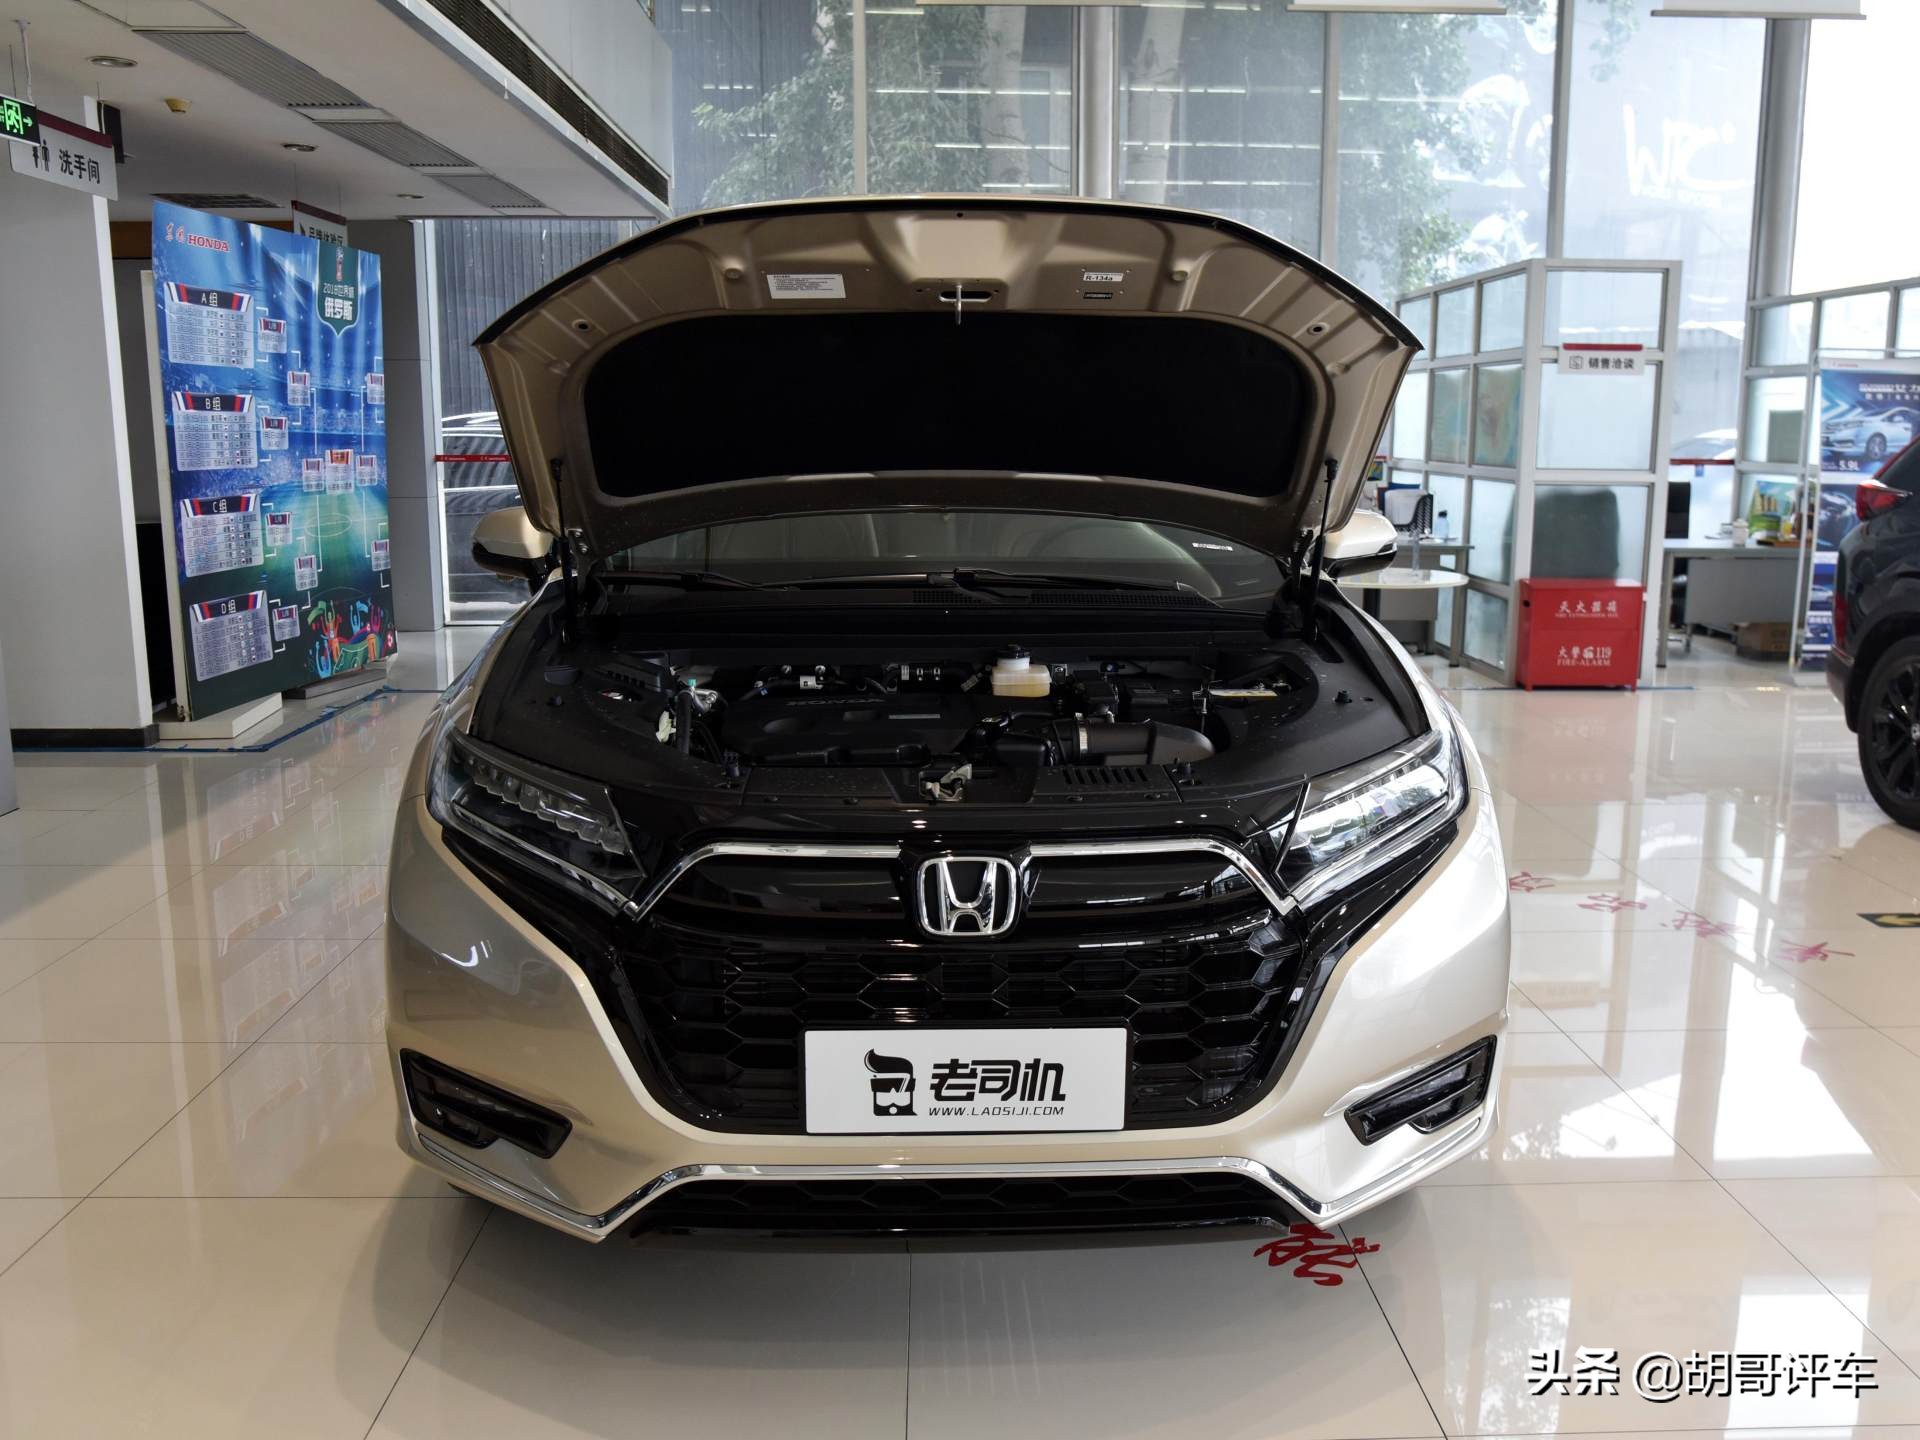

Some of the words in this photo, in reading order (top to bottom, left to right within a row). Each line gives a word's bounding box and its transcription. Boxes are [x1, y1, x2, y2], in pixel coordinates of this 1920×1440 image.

[59, 148, 101, 184] 洗手间
[187, 233, 230, 252] HONDA
[325, 297, 353, 320] 俄罗斯
[1588, 357, 1635, 370] 销售洽谈
[930, 1058, 1066, 1102] 老司机
[929, 1106, 1065, 1116] WWW.LAOSIJI.COM
